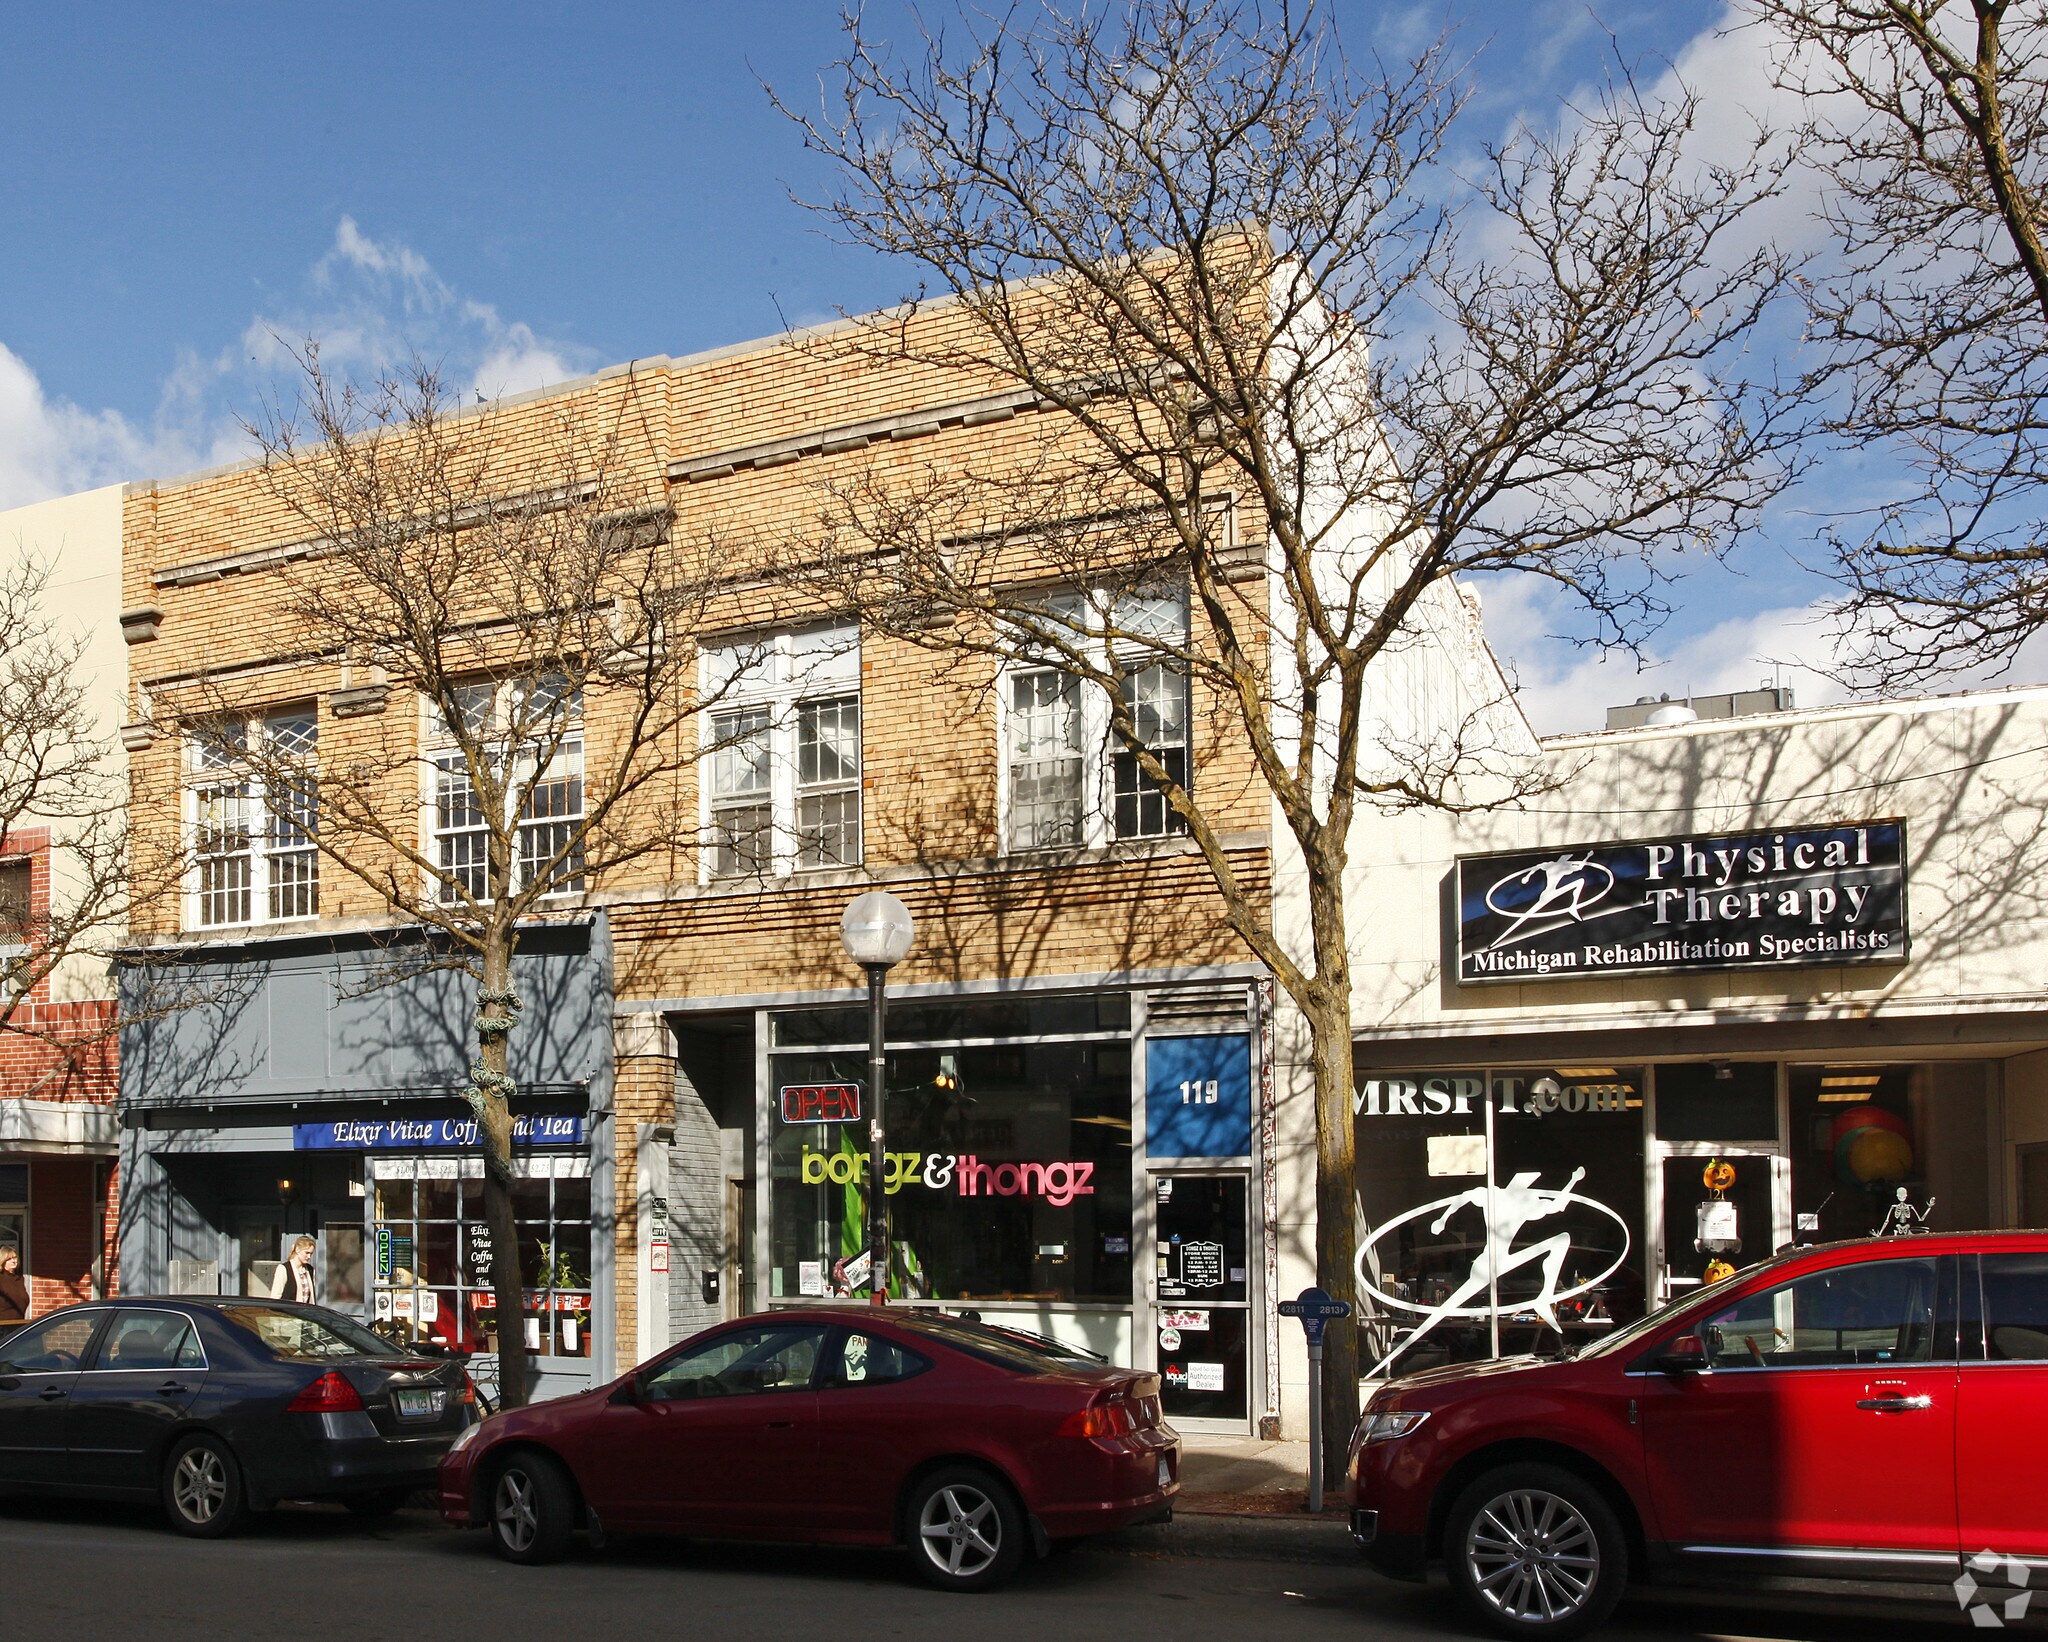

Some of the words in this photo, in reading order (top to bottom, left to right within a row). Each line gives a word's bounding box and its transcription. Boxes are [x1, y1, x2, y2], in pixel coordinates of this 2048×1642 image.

[1644, 829, 1870, 887] Physical
[1645, 881, 1872, 926] Therapy
[1473, 951, 1577, 973] Michigan
[1583, 938, 1750, 966] Rehabilitation
[1759, 929, 1889, 959] Specialists
[1180, 1080, 1218, 1104] 119
[784, 1087, 859, 1120] OPEN
[334, 1120, 383, 1145] Elixir
[386, 1117, 432, 1140] Vitae
[509, 1114, 536, 1136] nd
[540, 1113, 573, 1136] Tea
[923, 1153, 957, 1189] &
[956, 1155, 1094, 1207] thongz
[1709, 1188, 1725, 1200] 121
[471, 1225, 490, 1237] Elixi
[472, 1238, 491, 1248] Vitae
[379, 1232, 389, 1273] OPEN
[475, 1263, 491, 1274] and
[476, 1277, 489, 1287] Tea
[1285, 1305, 1305, 1313] 2811
[1319, 1305, 1340, 1314] 2813
[1165, 1313, 1202, 1328] RAW
[1166, 1370, 1188, 1386] liquid
[1189, 1373, 1222, 1381] Authorized
